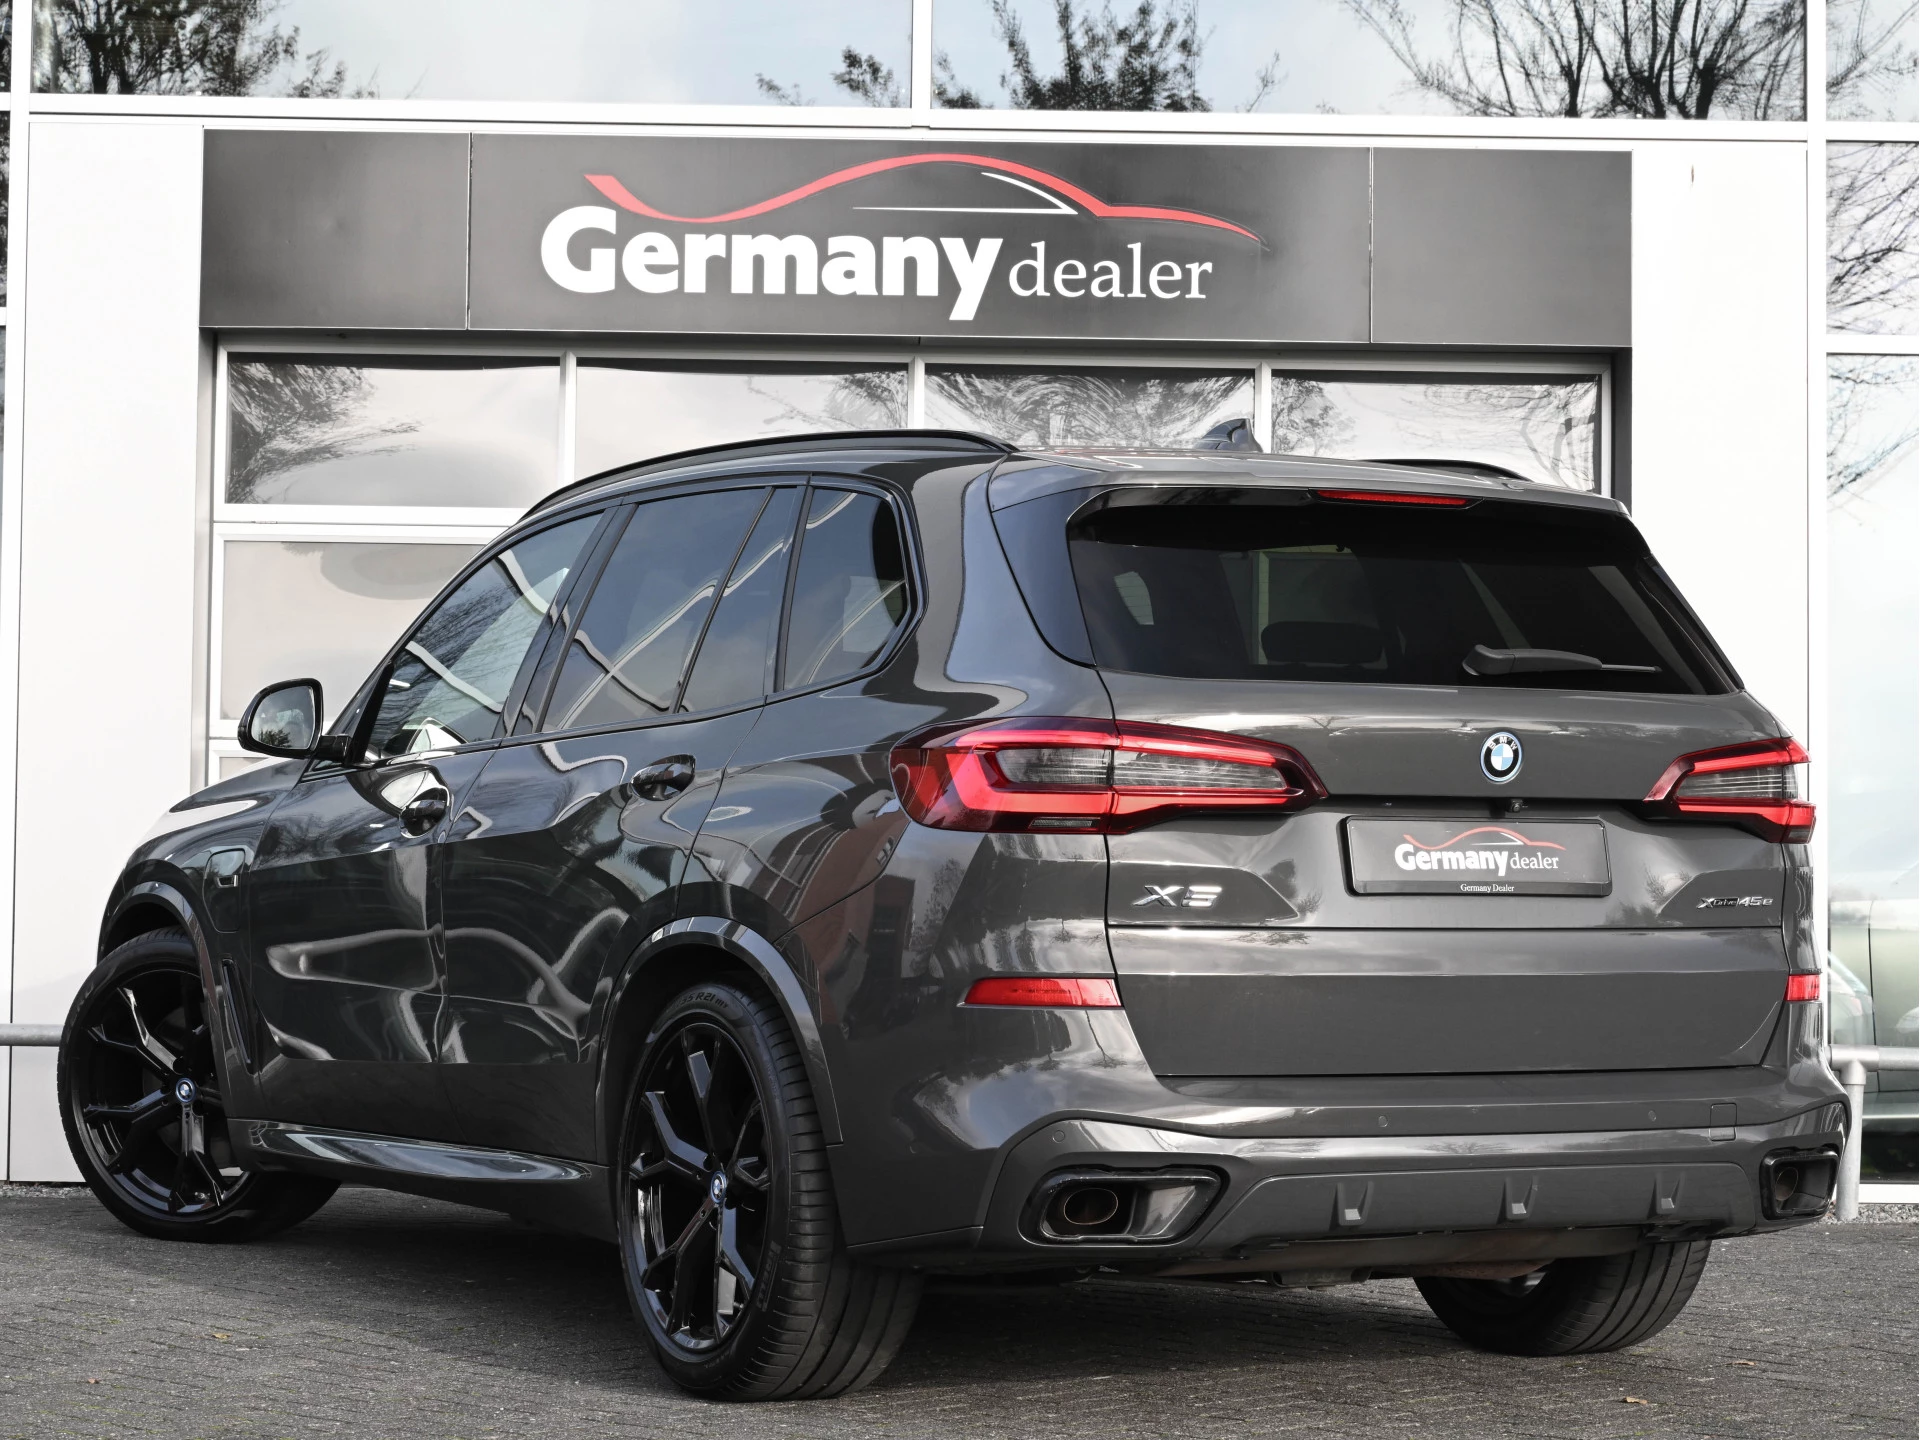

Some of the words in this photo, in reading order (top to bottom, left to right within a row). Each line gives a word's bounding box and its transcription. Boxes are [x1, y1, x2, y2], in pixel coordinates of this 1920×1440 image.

[540, 205, 1003, 321] Germany
[1008, 241, 1213, 299] dealer
[1487, 736, 1518, 750] BMW
[1394, 843, 1508, 876] Germany
[1510, 852, 1559, 869] dealer
[1132, 885, 1222, 907] X5
[1460, 883, 1491, 893] Germany
[1492, 883, 1515, 892] Dealer
